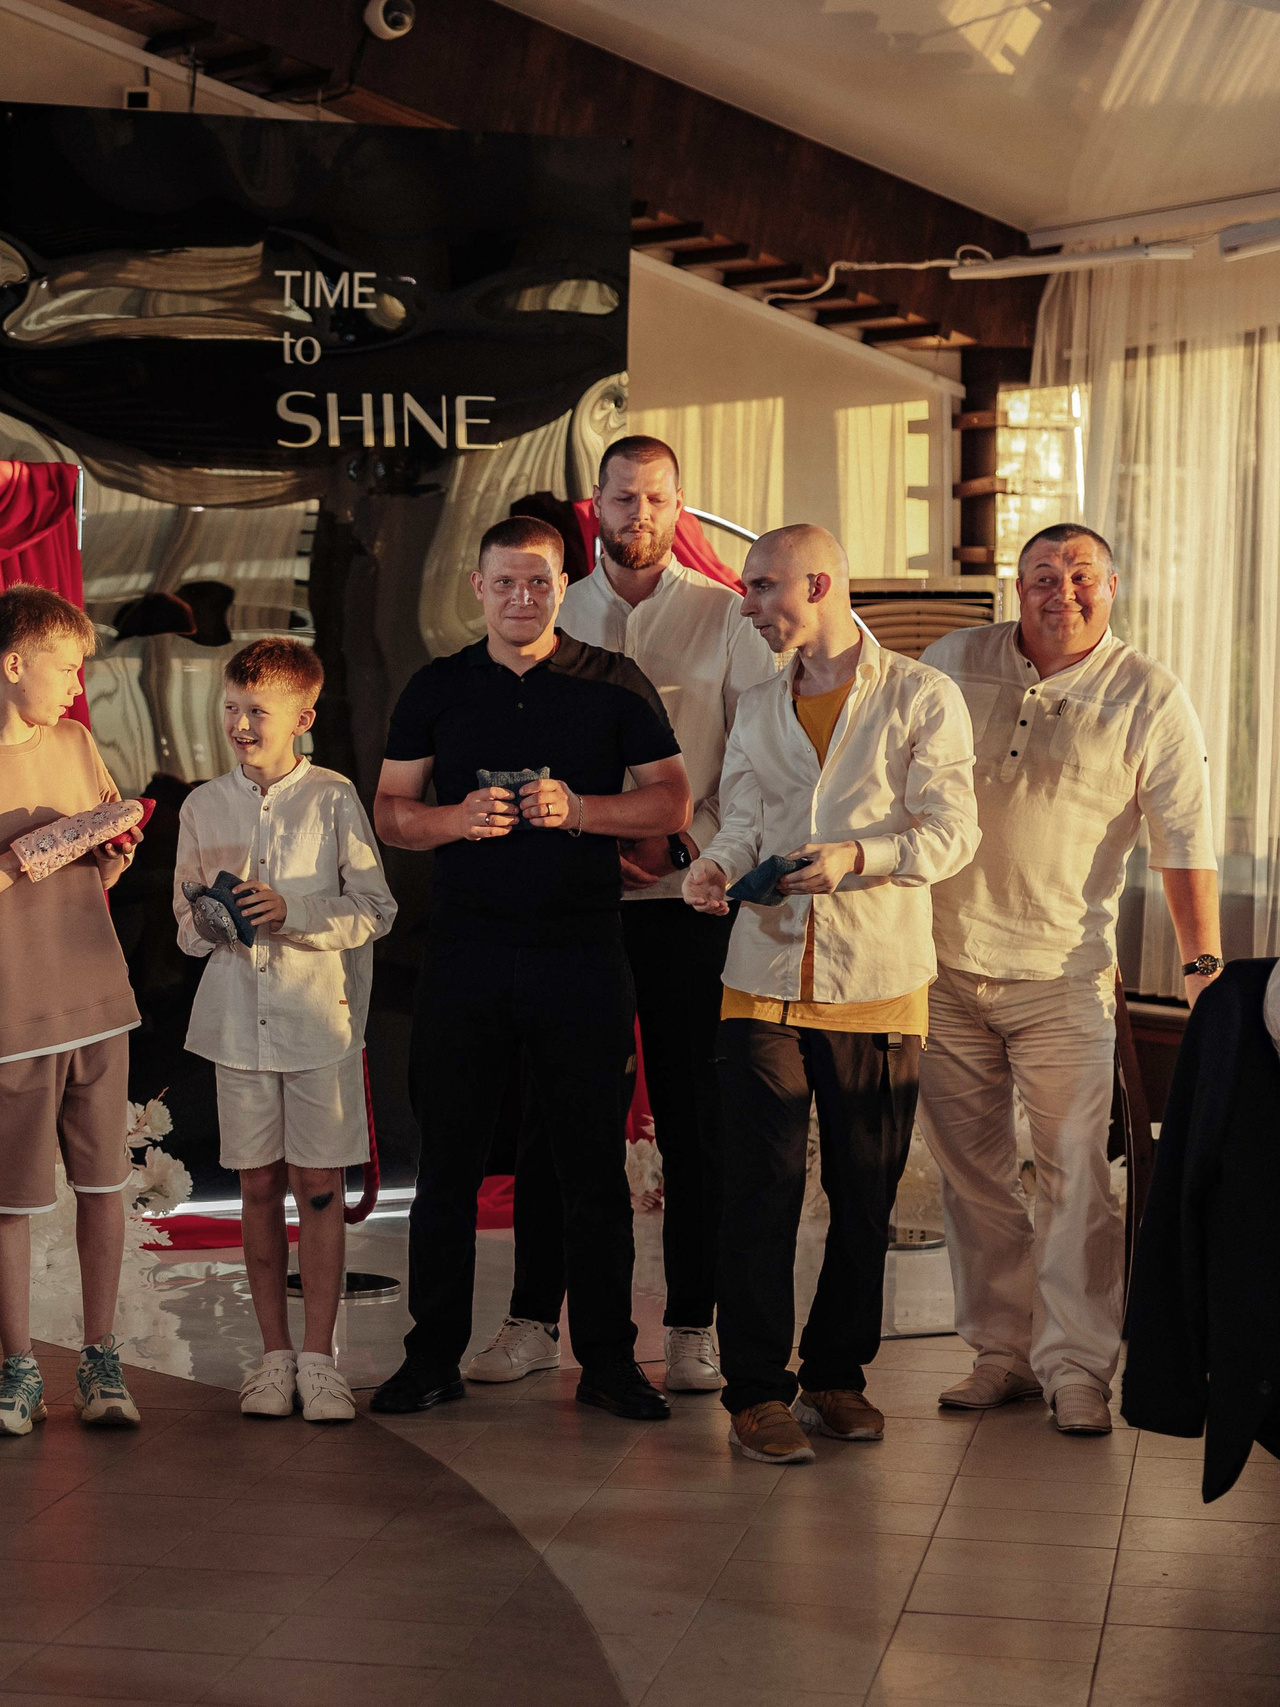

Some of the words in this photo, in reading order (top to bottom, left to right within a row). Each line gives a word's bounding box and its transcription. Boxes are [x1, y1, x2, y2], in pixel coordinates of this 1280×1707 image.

[274, 270, 377, 309] TIME
[283, 331, 321, 365] to
[276, 390, 500, 449] SHINE
